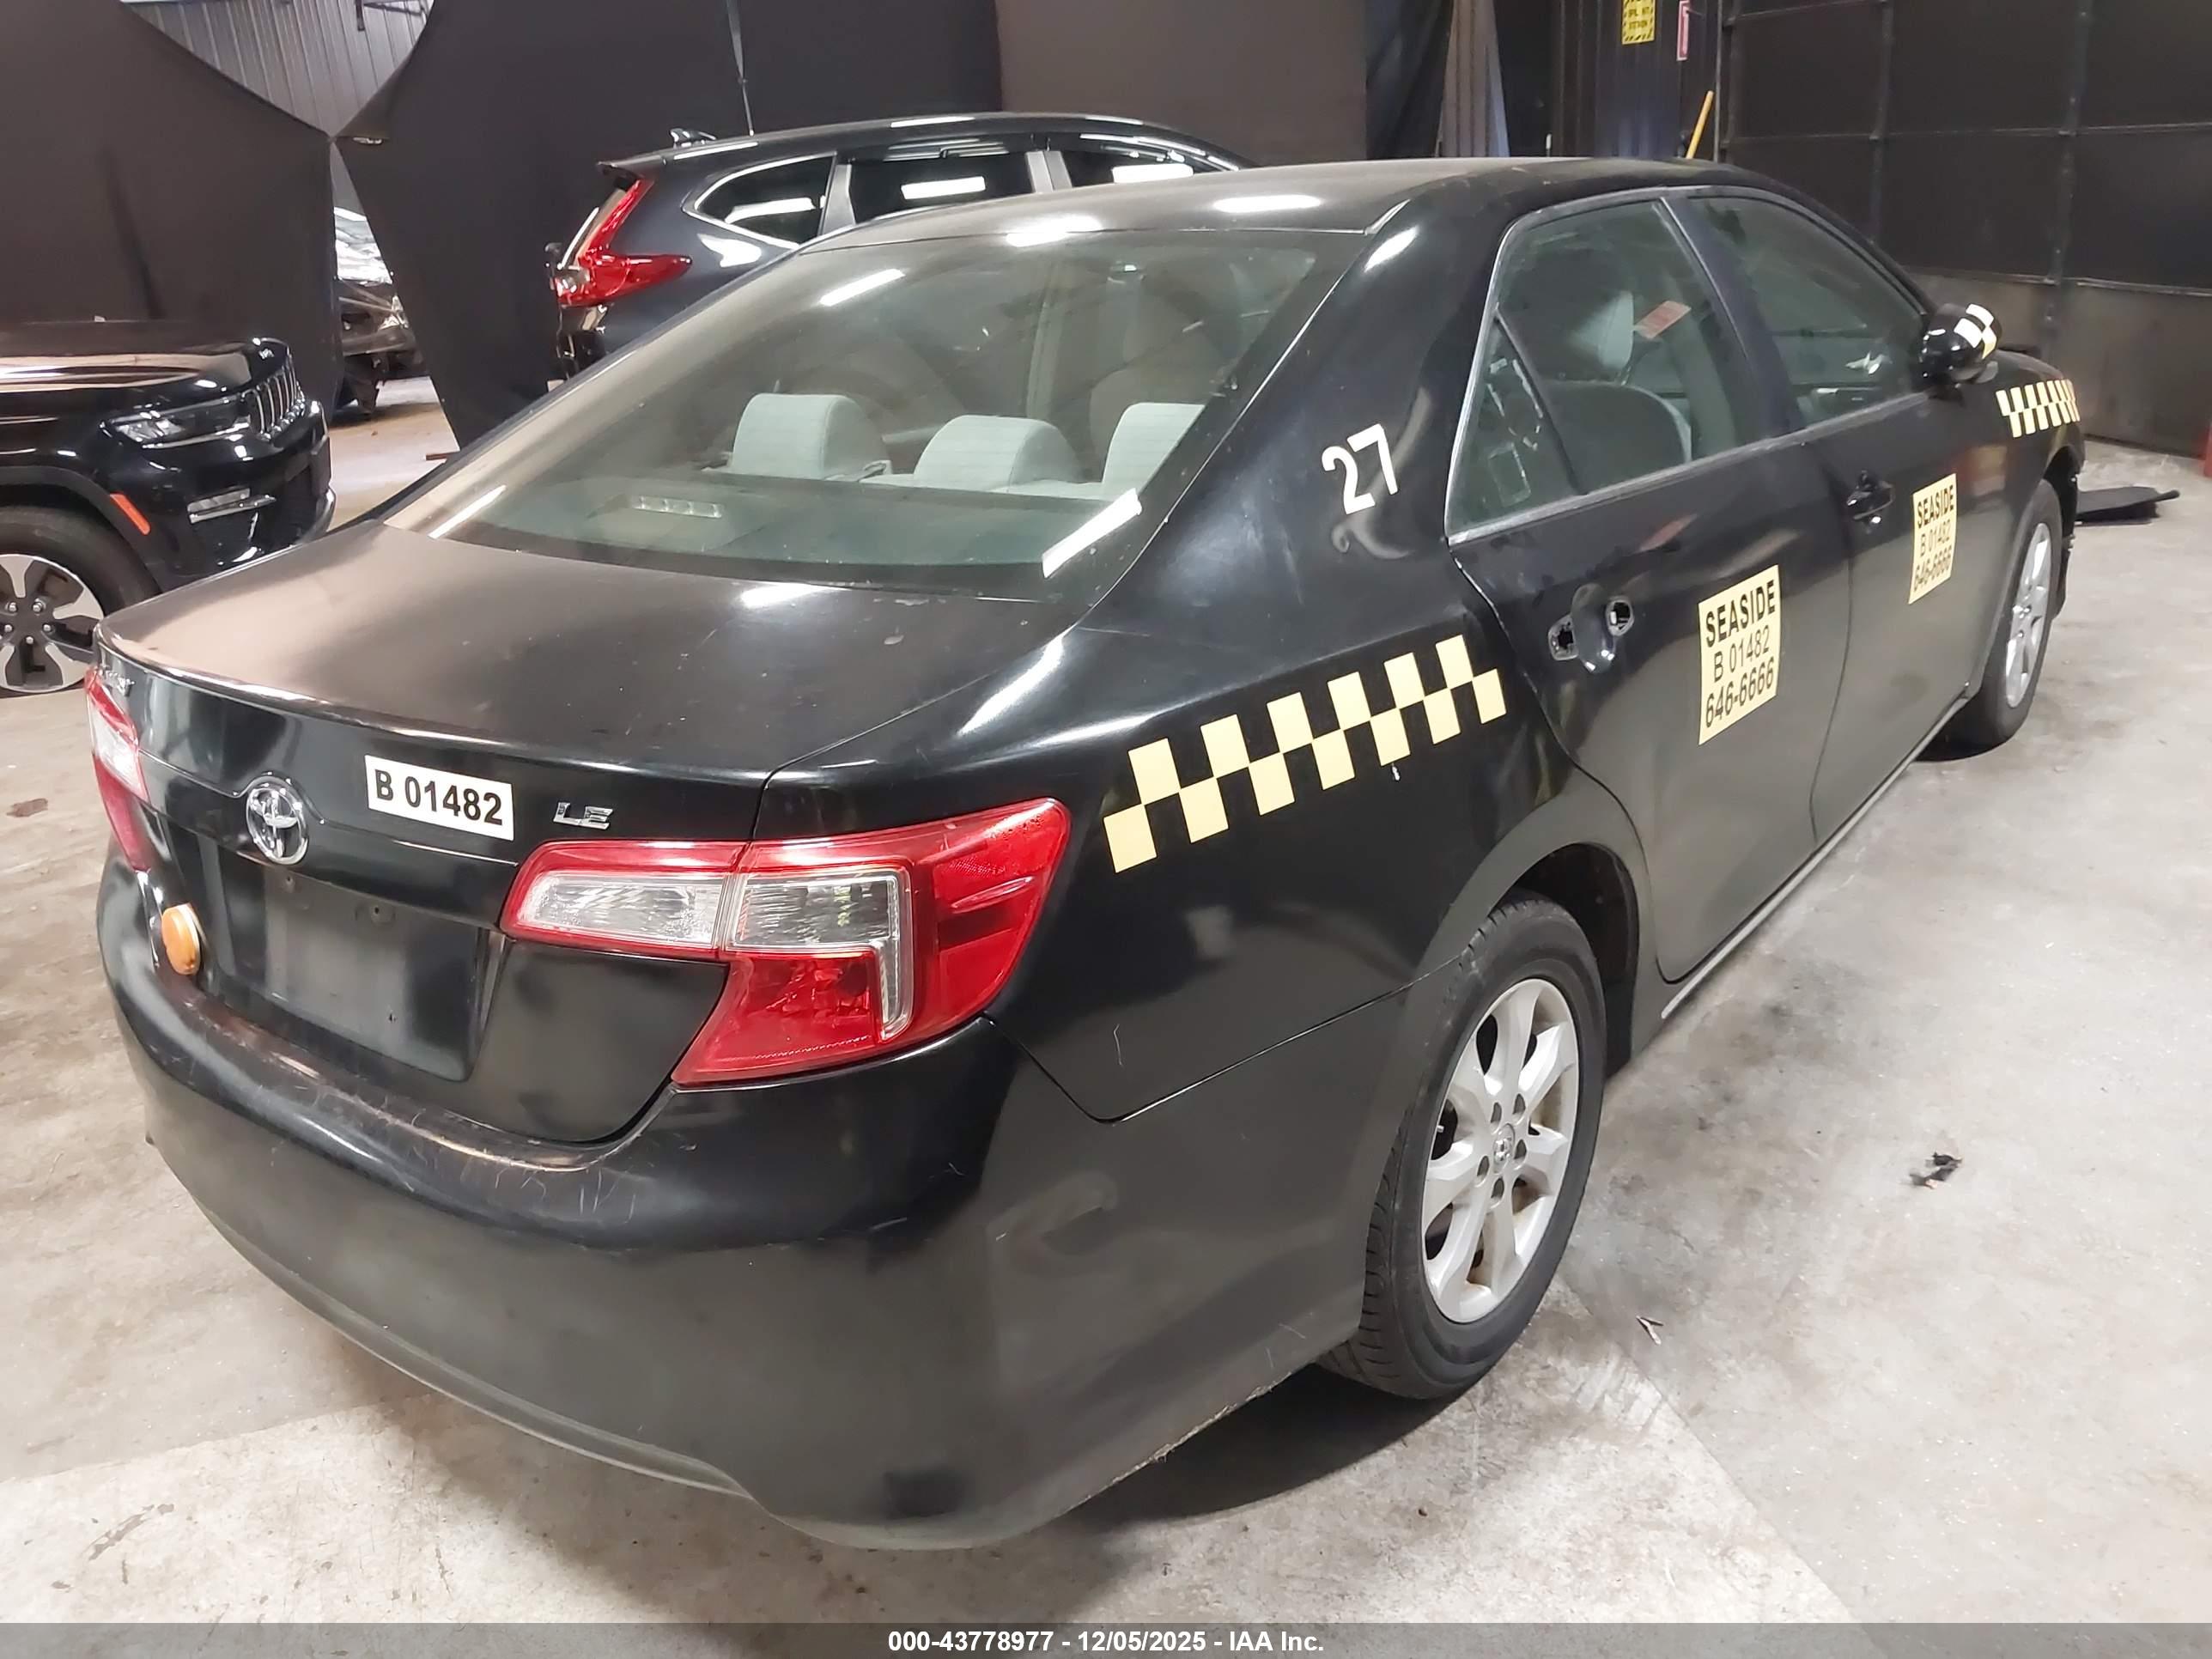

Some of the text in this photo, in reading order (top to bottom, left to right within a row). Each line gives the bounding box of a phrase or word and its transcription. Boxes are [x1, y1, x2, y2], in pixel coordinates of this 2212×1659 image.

[1321, 422, 1399, 515] 27
[1917, 484, 1954, 529] SEASIDE
[1920, 533, 1927, 557] B
[1705, 579, 1776, 648] SEASIDE
[1713, 624, 1770, 684] B 01482
[1705, 656, 1775, 728] 646-6666
[374, 769, 503, 826] B 01482
[552, 801, 614, 830] LE
